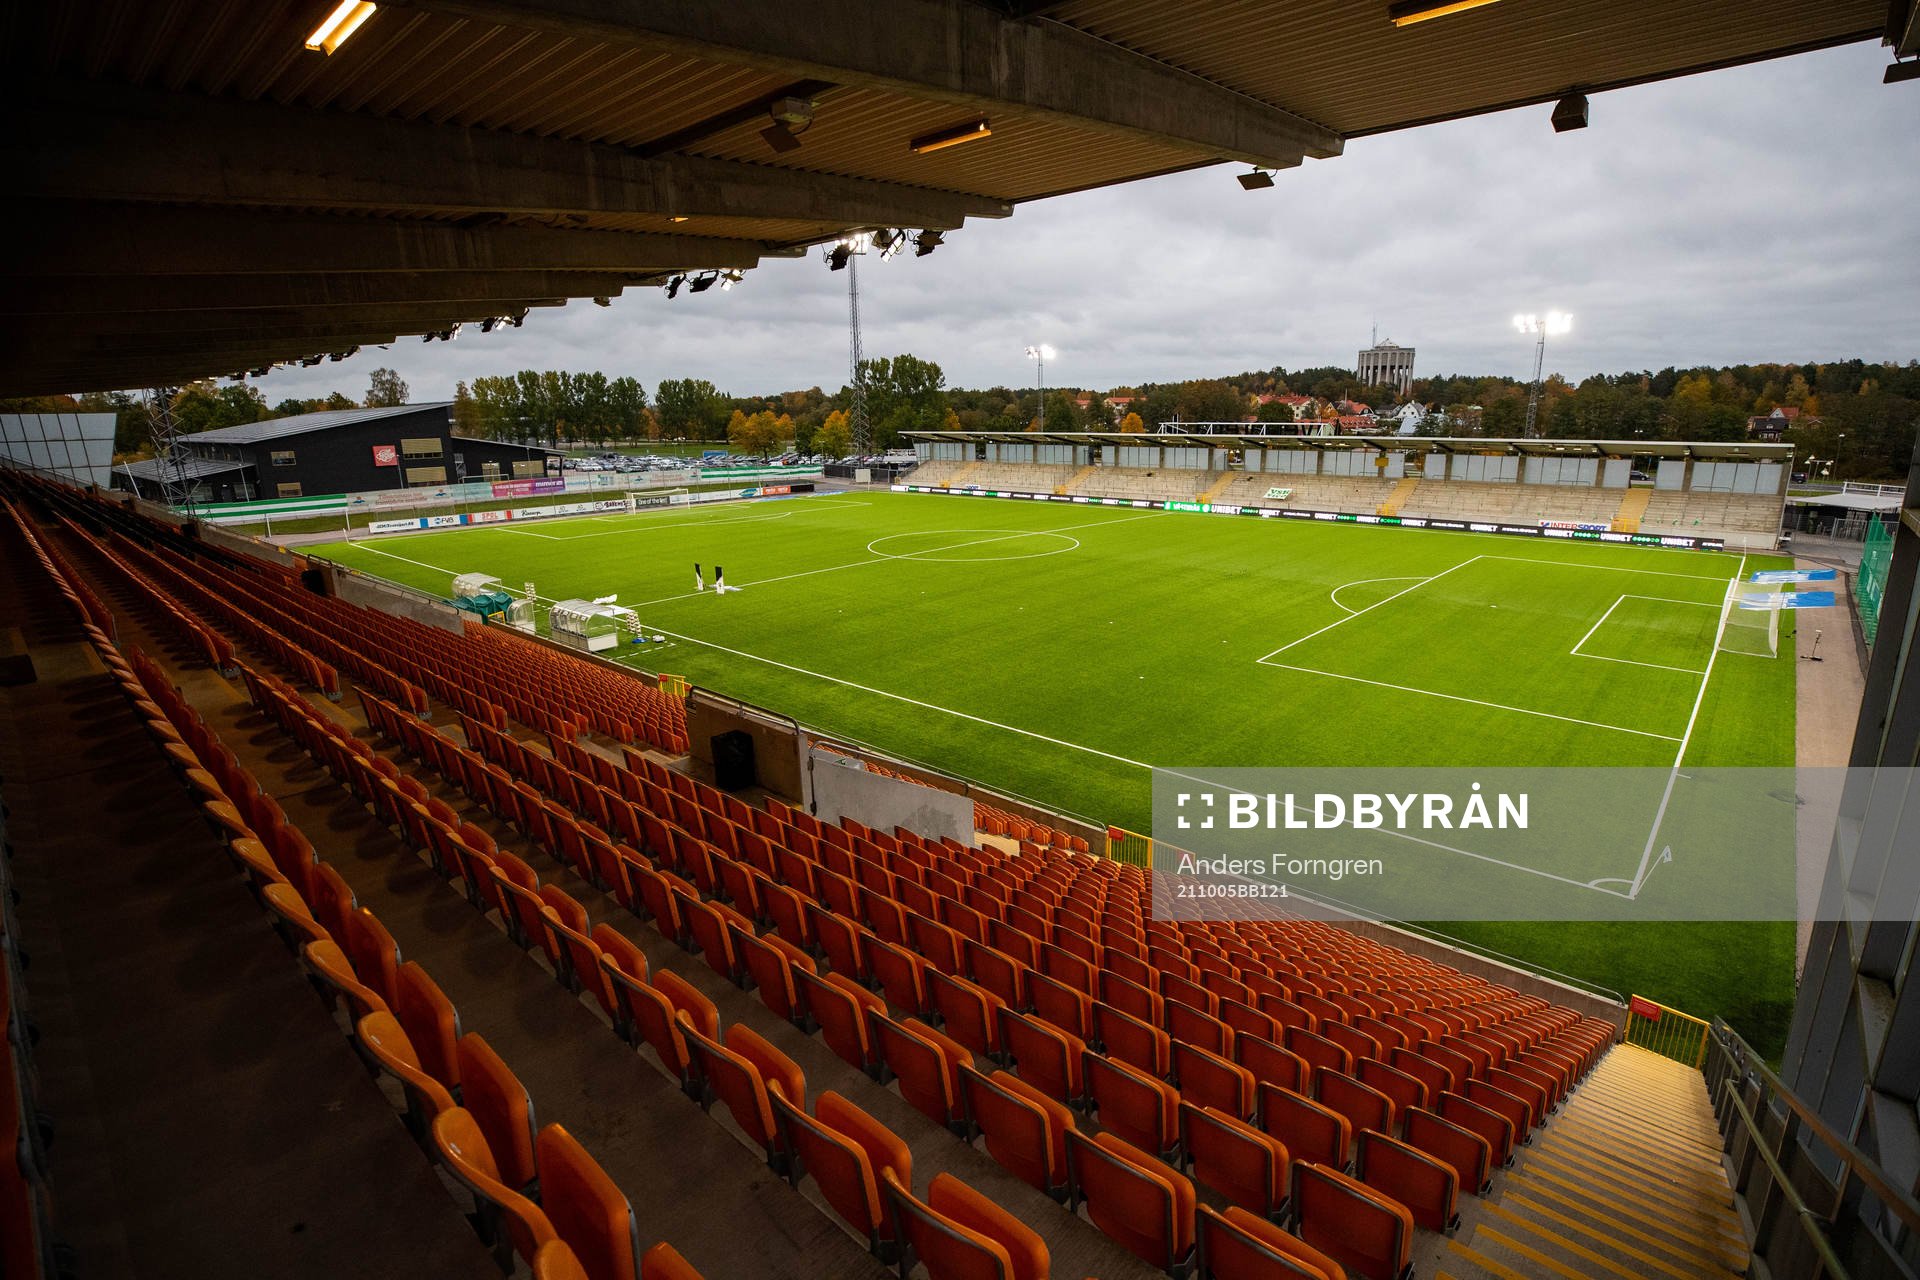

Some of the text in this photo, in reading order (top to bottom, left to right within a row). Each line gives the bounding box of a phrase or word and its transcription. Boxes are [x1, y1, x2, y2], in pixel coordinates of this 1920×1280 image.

[1211, 504, 1242, 514] UNIBET
[1550, 522, 1607, 531] INTERSPORT
[1600, 533, 1632, 542] UNIBET
[1661, 537, 1695, 547] UNIBET
